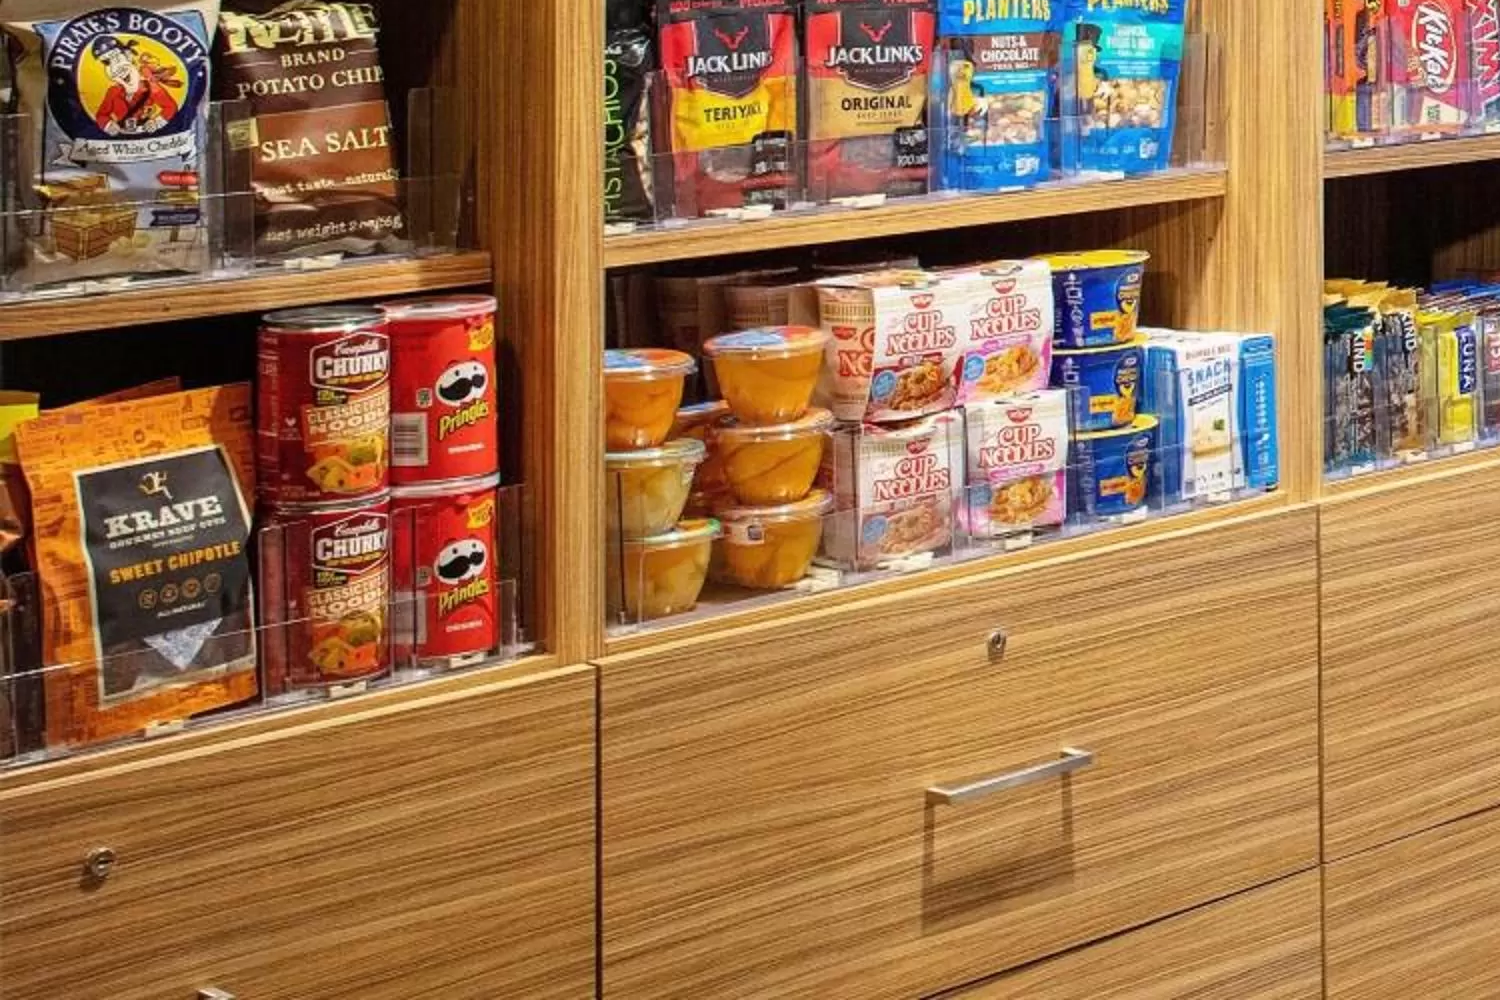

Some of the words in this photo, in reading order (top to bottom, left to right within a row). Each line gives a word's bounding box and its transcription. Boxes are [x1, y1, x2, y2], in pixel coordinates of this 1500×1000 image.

[52, 12, 121, 70] PIRATE'S
[128, 13, 204, 64] BOOTY
[826, 46, 875, 67] JACK
[980, 47, 1041, 62] CHOCOLATE
[280, 47, 345, 68] BRAND
[687, 54, 731, 77] JACK
[236, 73, 325, 99] POTATO
[841, 95, 913, 111] ORIGINAL
[260, 136, 321, 163] SEA
[324, 125, 389, 154] SALT
[986, 293, 1027, 318] CUP
[904, 311, 943, 333] CUP
[969, 308, 1042, 341] NOODLES
[1402, 310, 1417, 351] KIND
[886, 326, 956, 357] NOODLES
[1353, 331, 1365, 372] KIND
[316, 349, 389, 380] CHUNKY
[1187, 359, 1232, 387] SNACK
[1462, 329, 1476, 390] LUNA
[438, 401, 490, 441] Pringles
[997, 423, 1042, 446] CUP
[895, 453, 938, 479] CUP
[978, 436, 1055, 468] NOODLES
[874, 468, 949, 501] NOODLES
[104, 495, 223, 539] KRAVE
[315, 528, 389, 562] CHUNKY
[109, 558, 164, 585] SWEET
[167, 540, 242, 572] CHIPOTLE
[438, 577, 490, 618] Pringles
